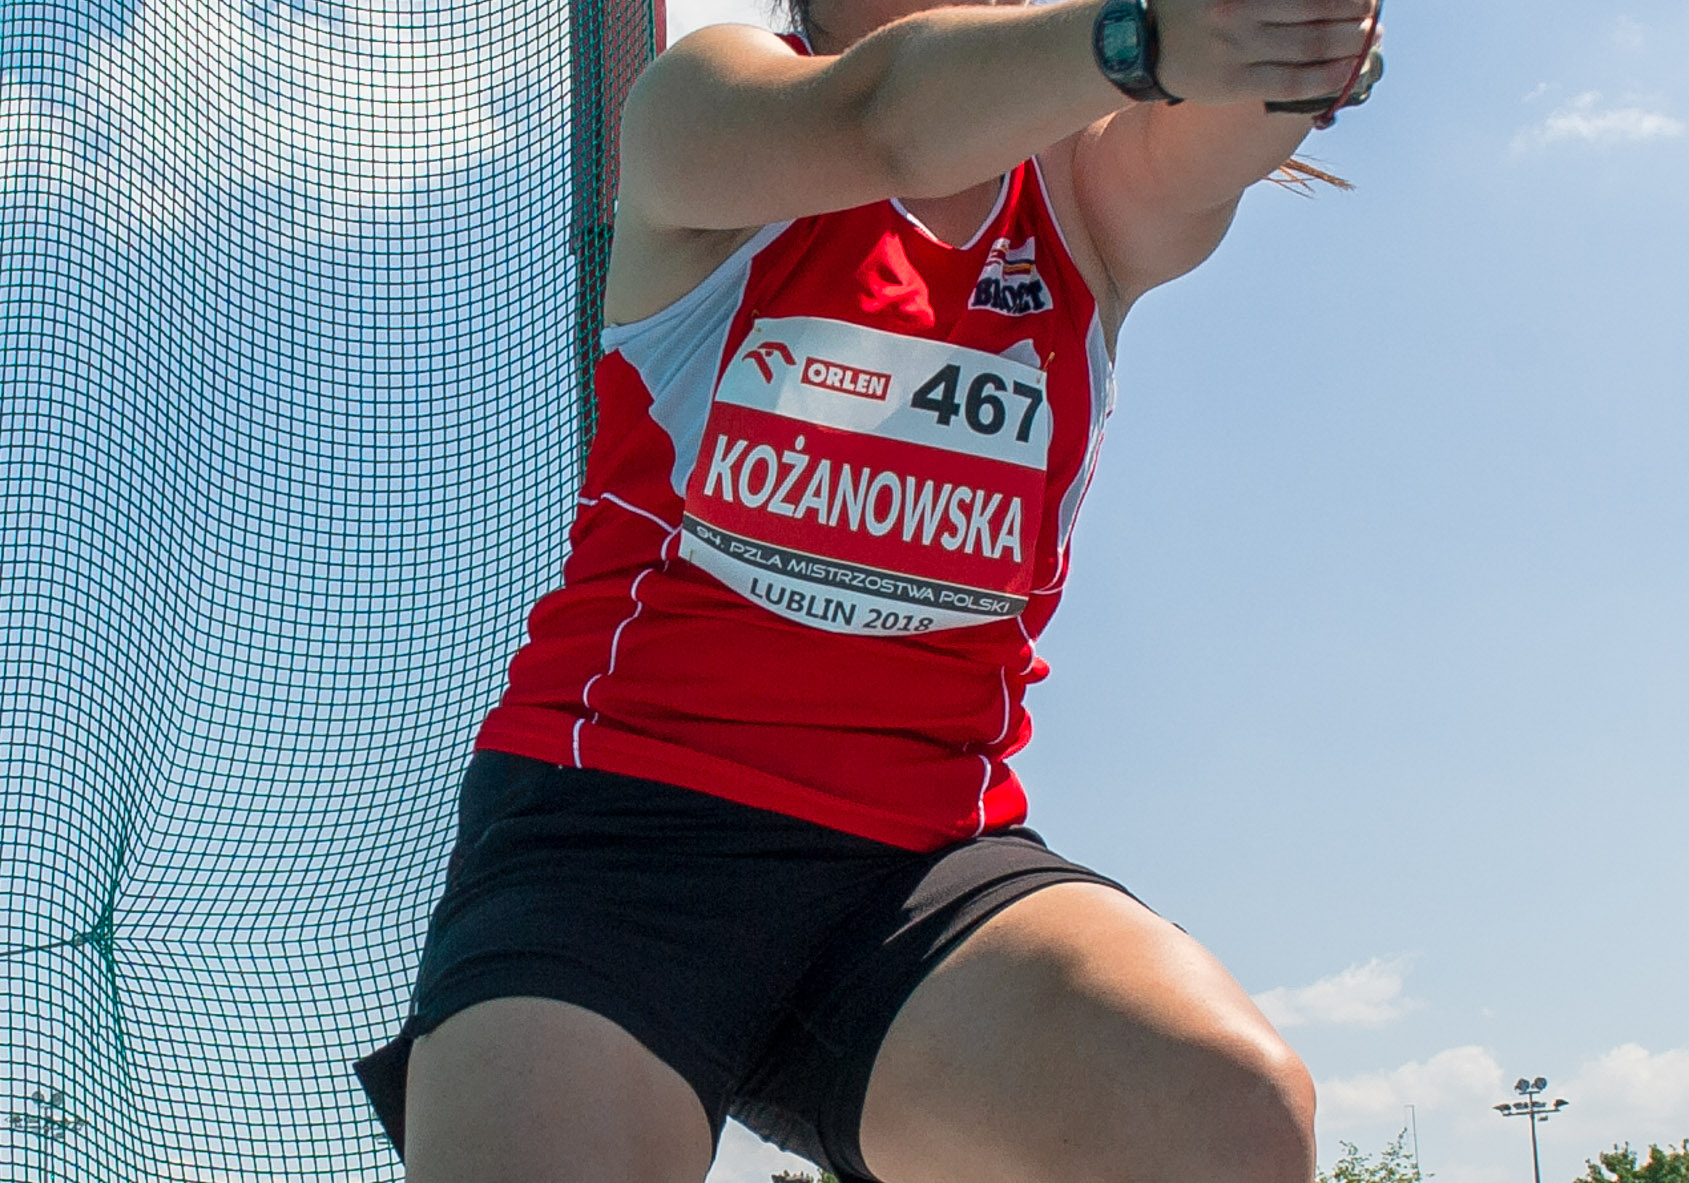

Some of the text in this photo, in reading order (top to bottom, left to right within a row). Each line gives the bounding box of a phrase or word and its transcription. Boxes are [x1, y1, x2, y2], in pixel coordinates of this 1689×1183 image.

[807, 361, 887, 398] ORLEN
[910, 364, 1043, 443] 467
[703, 434, 1023, 563] KOŻANOWSKA
[696, 526, 1010, 614] 94. PZLA MISTRZOSTWA POLSKI
[750, 578, 934, 633] LUBLIN 2018
